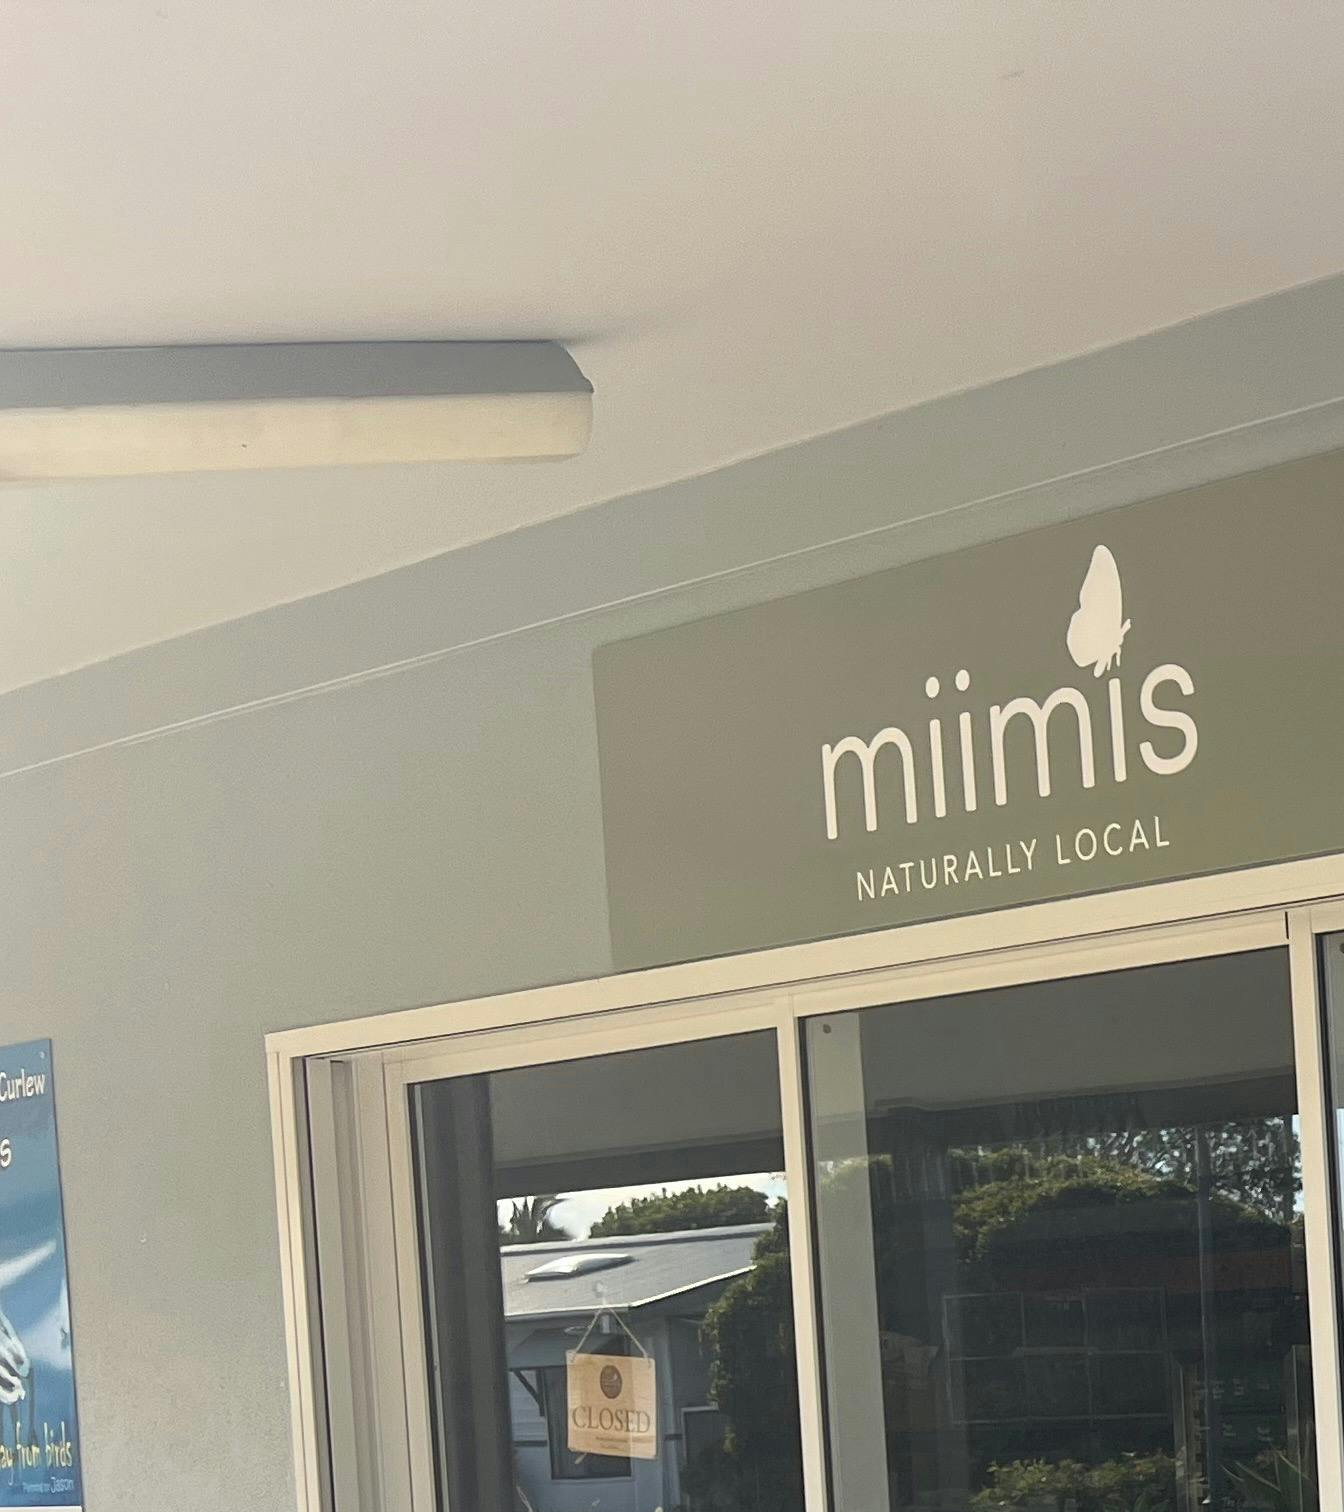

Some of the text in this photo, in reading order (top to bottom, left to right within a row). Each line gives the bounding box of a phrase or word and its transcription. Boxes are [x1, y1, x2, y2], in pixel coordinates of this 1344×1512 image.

[821, 663, 1199, 840] miimis
[855, 815, 1170, 901] NATURALLY LOCAL
[0, 1068, 46, 1101] Curlew
[572, 1405, 651, 1434] CLOSED
[16, 1421, 40, 1472] from
[43, 1421, 73, 1469] birds
